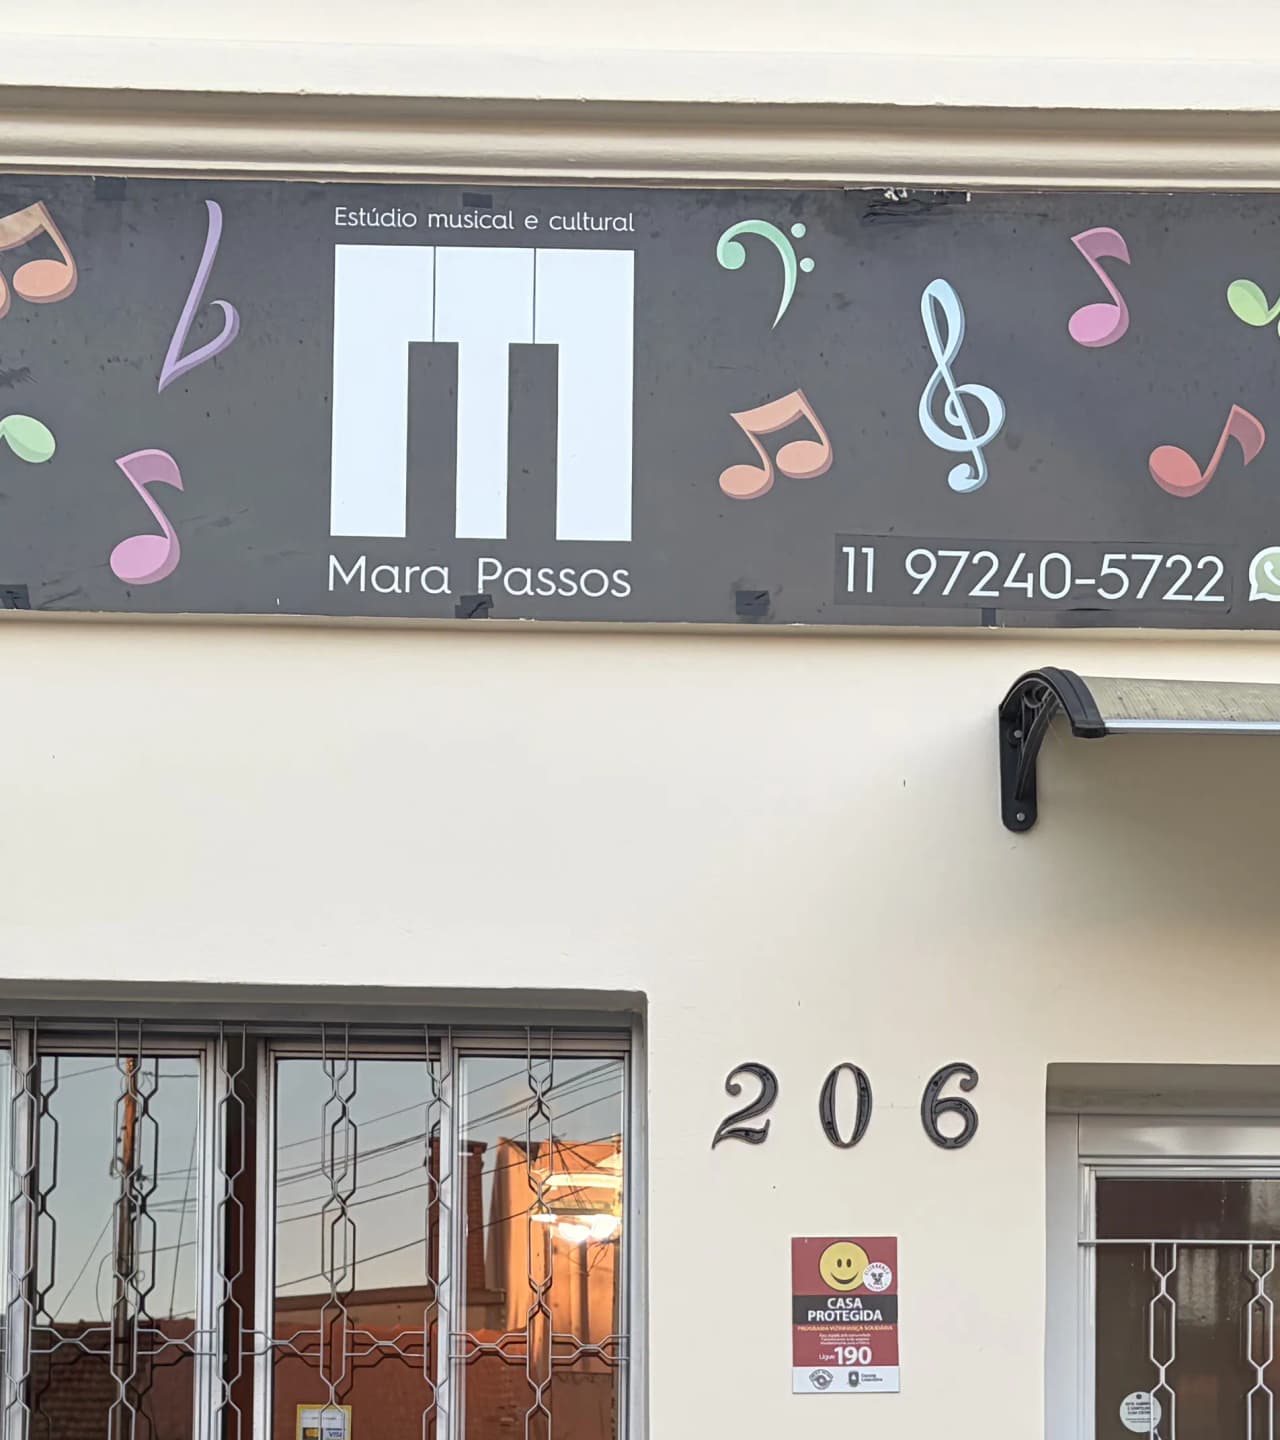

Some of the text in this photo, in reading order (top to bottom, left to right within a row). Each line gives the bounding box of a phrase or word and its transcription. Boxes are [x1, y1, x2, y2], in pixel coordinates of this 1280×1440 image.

[335, 206, 635, 232] Estúdio musical e cultural
[328, 554, 631, 598] Mara Passos
[842, 546, 1225, 602] 11 97240-5722
[711, 1062, 979, 1151] 206
[807, 1309, 883, 1322] PROTEGIDA
[827, 1297, 863, 1310] CASA
[834, 1346, 872, 1365] 190
